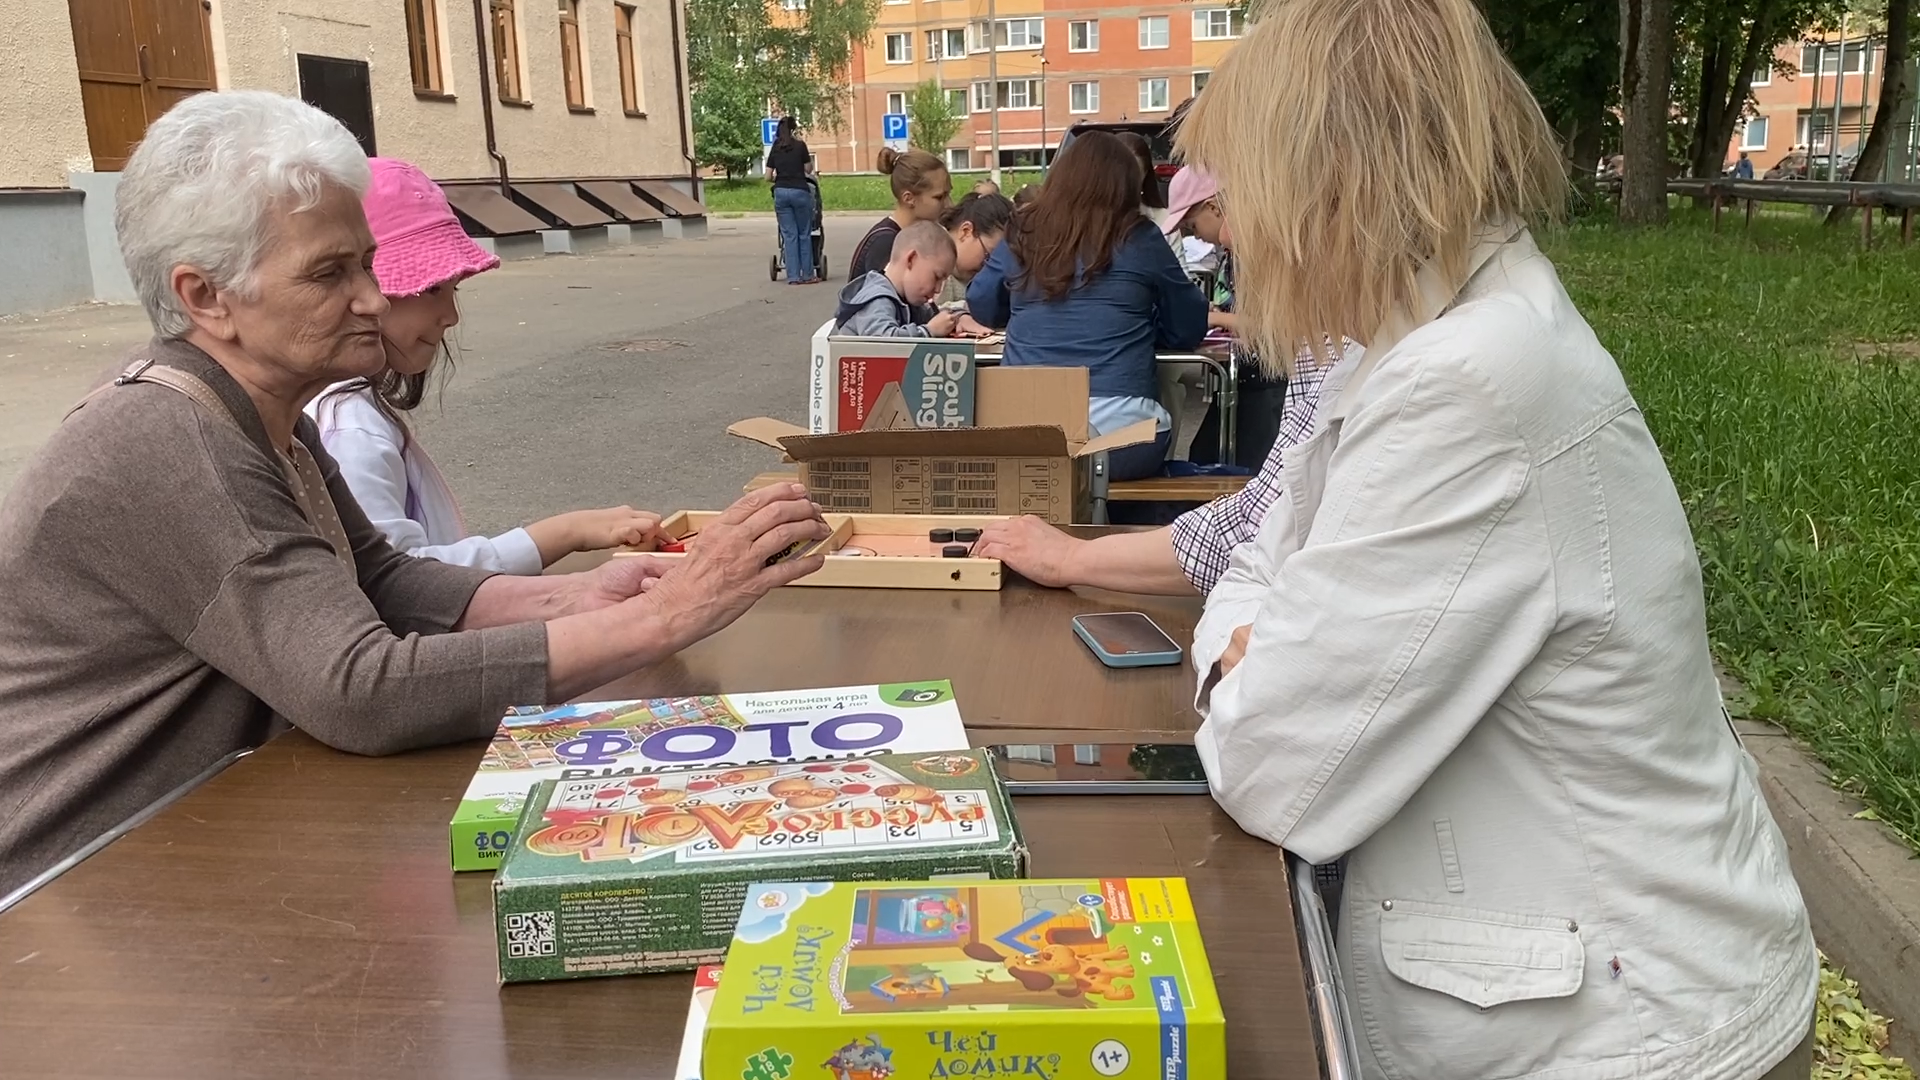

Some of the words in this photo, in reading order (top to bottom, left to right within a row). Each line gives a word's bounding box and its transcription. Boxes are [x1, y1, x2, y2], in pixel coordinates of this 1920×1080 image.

[889, 117, 903, 137] P
[813, 355, 824, 409] Double
[842, 361, 850, 393] детей
[849, 361, 857, 385] игра
[849, 386, 857, 407] для
[856, 361, 866, 420] Настольная
[916, 353, 944, 428] Sling
[745, 696, 832, 708] Настольная
[836, 693, 868, 702] игра
[778, 705, 813, 713] детей
[833, 702, 846, 710] 4
[554, 712, 903, 765] ФОТО
[889, 825, 917, 837] 23
[960, 820, 973, 832] 5
[475, 831, 512, 850] ФО
[759, 832, 787, 845] 62
[791, 831, 819, 844] 59
[561, 892, 593, 900] ДЕСЯТОЕ
[743, 964, 782, 1014] Чей
[925, 1030, 997, 1054] Чей
[759, 1061, 775, 1075] 18
[1097, 1051, 1123, 1068] 1+
